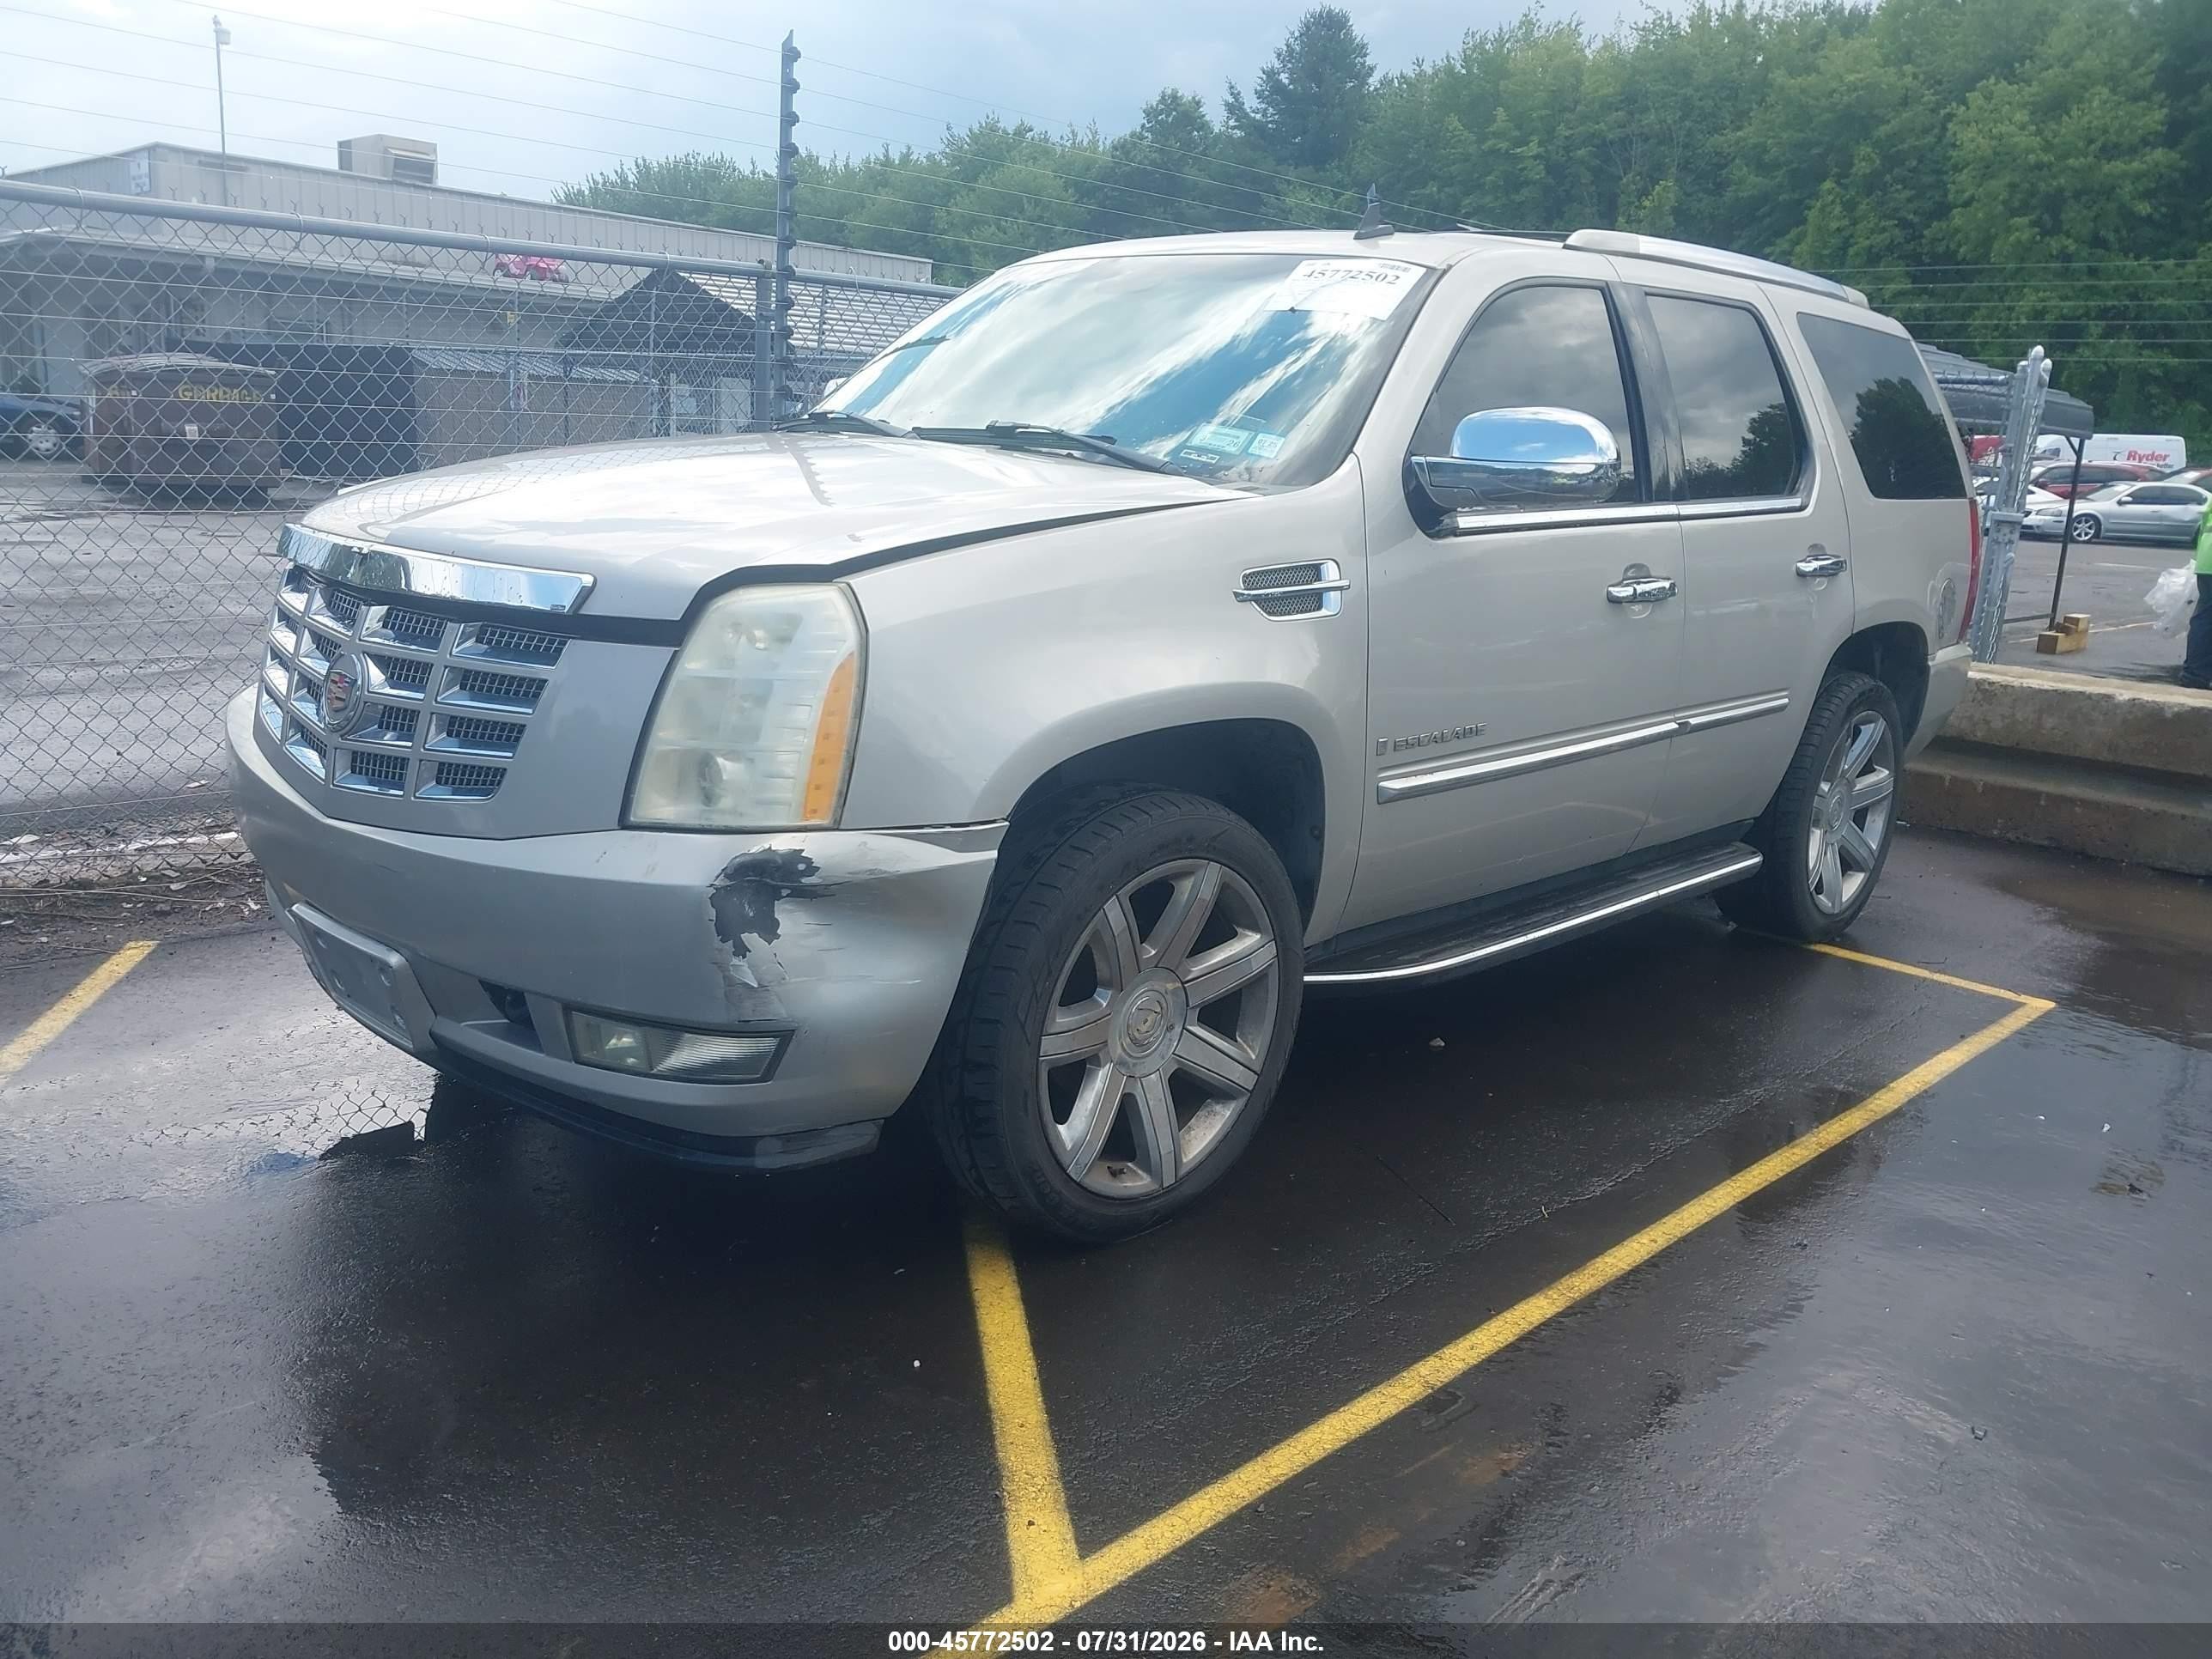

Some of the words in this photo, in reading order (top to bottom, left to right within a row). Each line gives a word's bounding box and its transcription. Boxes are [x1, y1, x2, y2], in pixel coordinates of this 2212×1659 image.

[1303, 269, 1401, 285] 45772502
[2126, 450, 2170, 463] Ryder
[1394, 722, 1489, 751] ESCALADE
